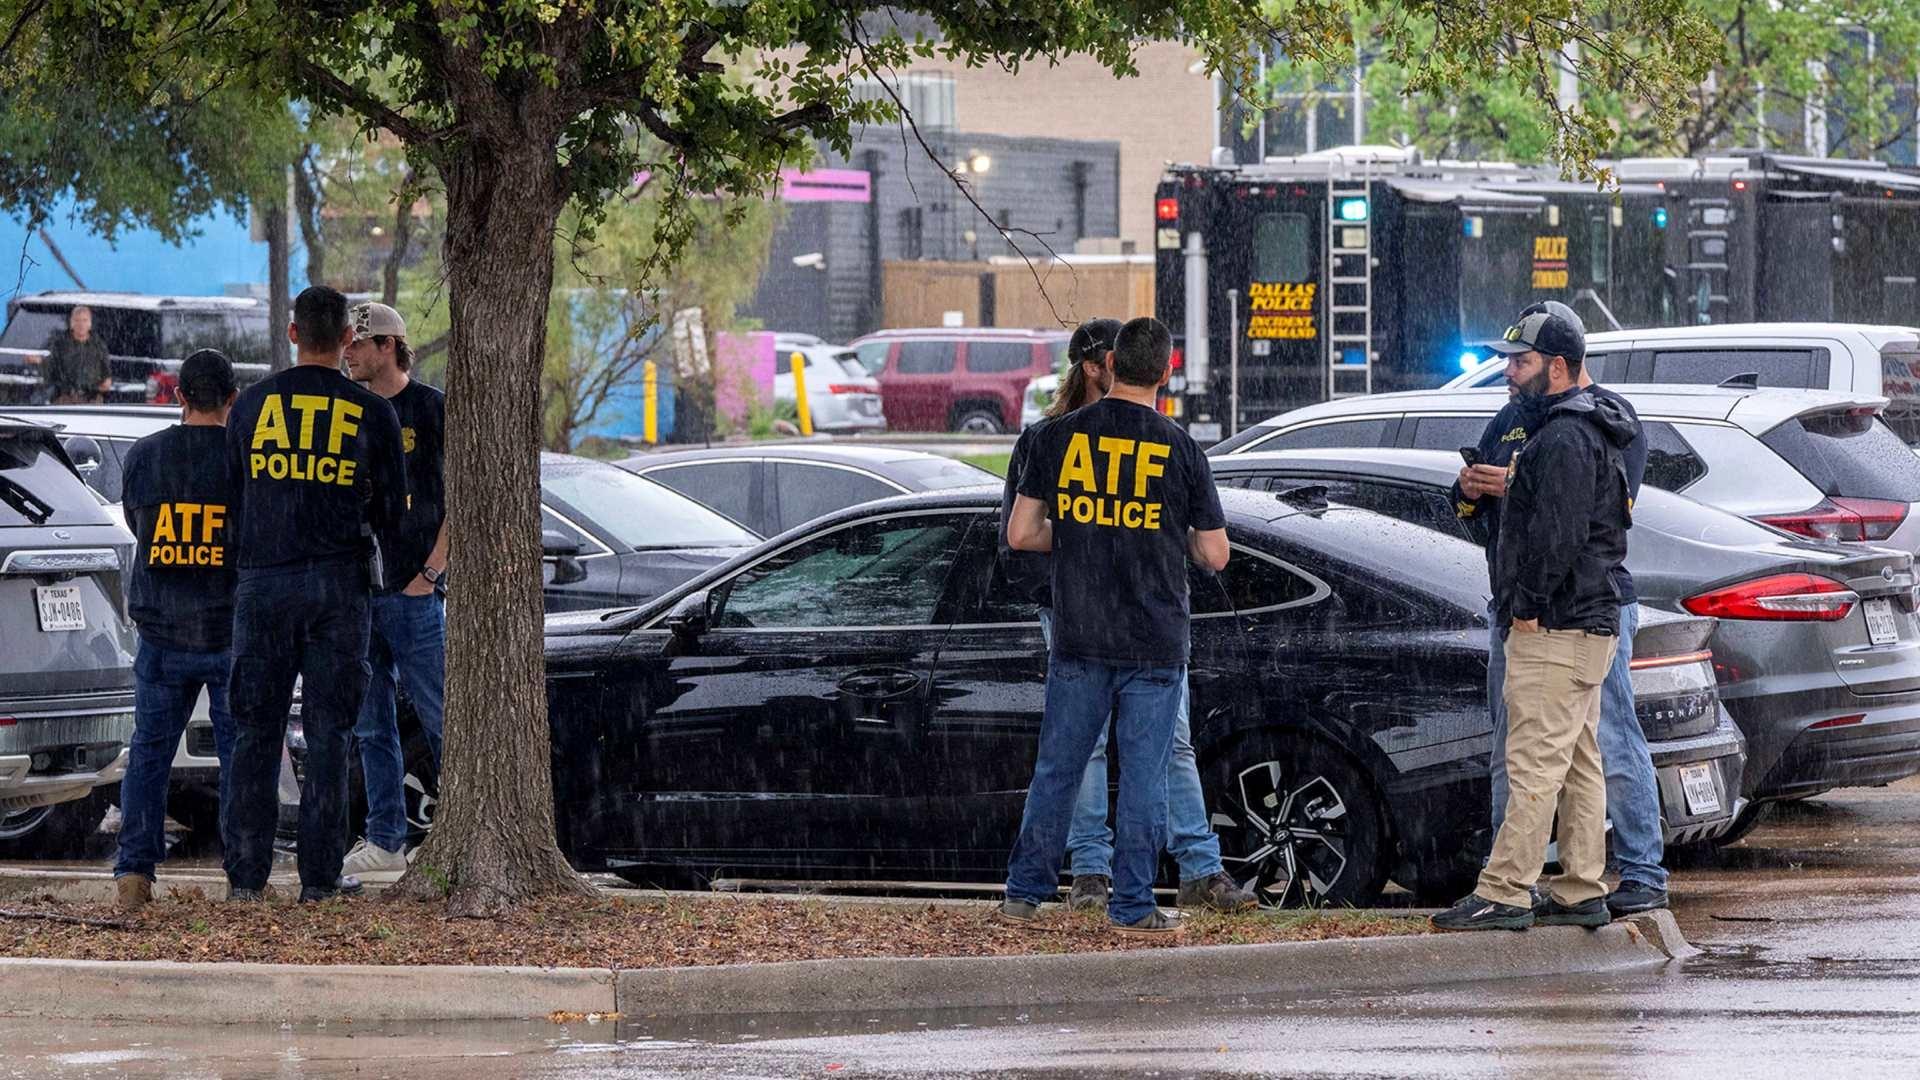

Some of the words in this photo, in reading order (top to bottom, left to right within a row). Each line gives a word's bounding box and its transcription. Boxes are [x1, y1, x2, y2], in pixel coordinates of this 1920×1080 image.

[1534, 236, 1568, 260] POLICE
[1249, 282, 1317, 297] DALLAS
[1251, 296, 1313, 310] POLICE
[1250, 315, 1313, 327] INCIDENT
[1248, 327, 1317, 338] COMMAND
[251, 394, 364, 454] ATF
[251, 453, 357, 486] POLICE
[1058, 432, 1171, 498] ATF
[1057, 493, 1162, 530] POLICE
[152, 503, 227, 543] ATF
[149, 545, 224, 566] POLICE
[50, 589, 68, 599] TEXAS
